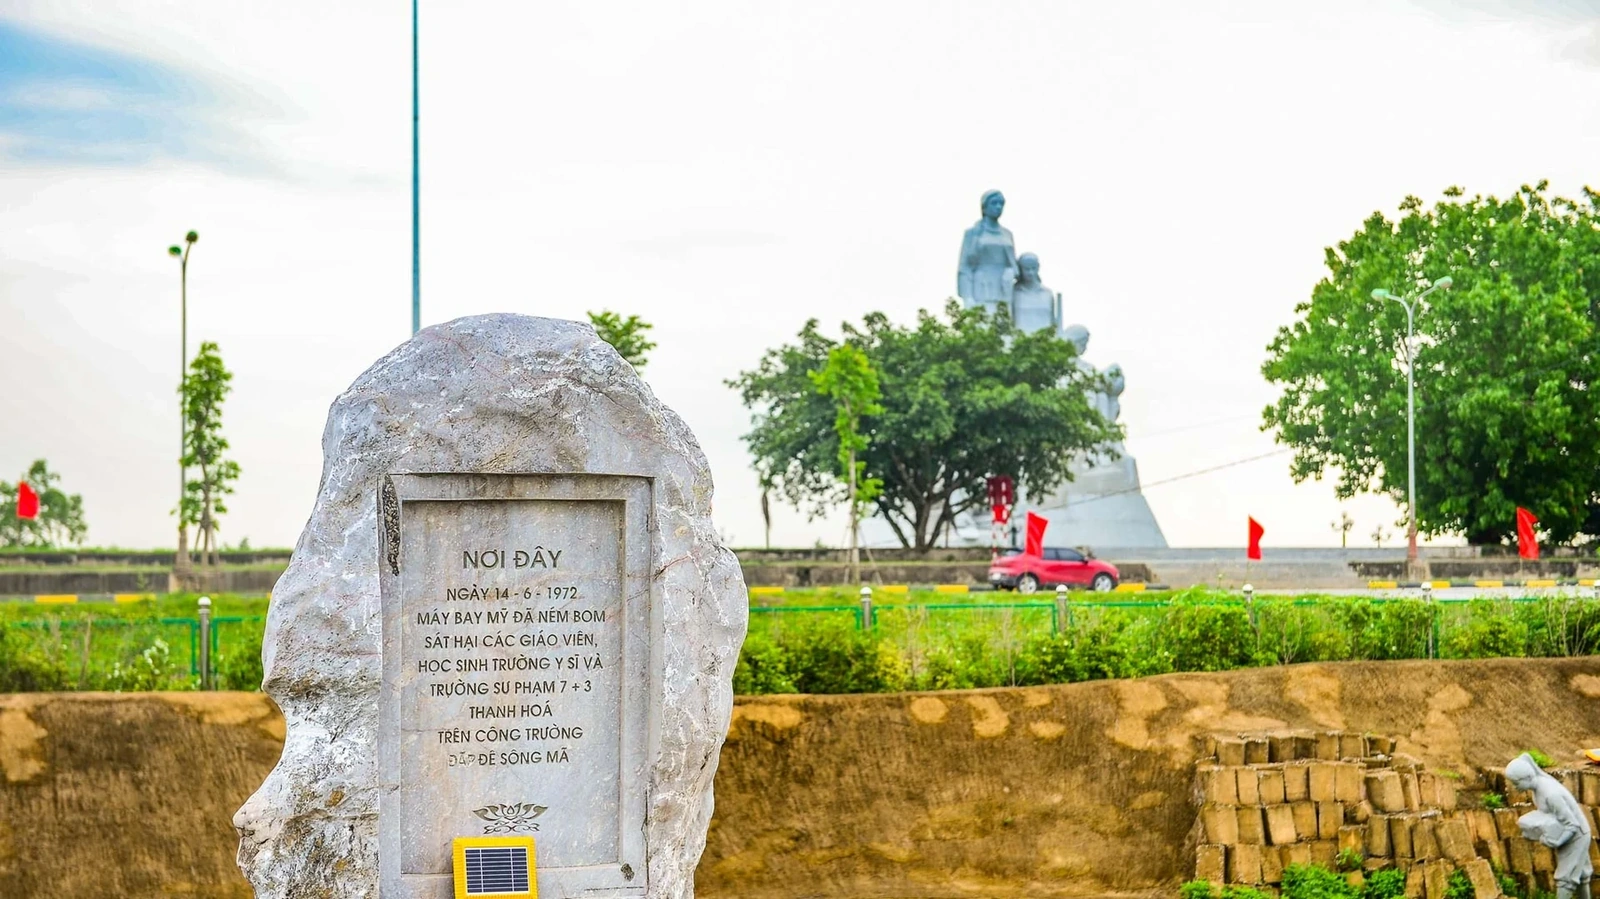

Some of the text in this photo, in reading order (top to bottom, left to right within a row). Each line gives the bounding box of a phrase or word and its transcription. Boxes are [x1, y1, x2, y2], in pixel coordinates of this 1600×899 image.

[463, 545, 562, 569] NƠI ĐÂY
[446, 584, 489, 601] NGÀY
[495, 587, 509, 600] 14
[523, 587, 532, 600] 6
[547, 586, 577, 600] 1972
[417, 606, 606, 625] MÁY BAY MỸ ĐÃ NÉM BOM
[425, 629, 598, 651] SÁT HẠI CÁC GIÁO VIÊN,
[418, 653, 604, 676] HỌC SINH TRƯỜNG Y SĨ VÀ
[493, 681, 510, 695] SƯ
[514, 680, 556, 697] PHẠM
[560, 680, 567, 693] 7
[584, 679, 592, 693] 3
[469, 700, 553, 719] THANH HOÁ
[438, 723, 583, 744] TRÊN CÔNG TRƯỜNG
[478, 749, 496, 766] ĐÊ
[500, 748, 542, 765] SÔNG
[546, 747, 569, 763] MÃ
